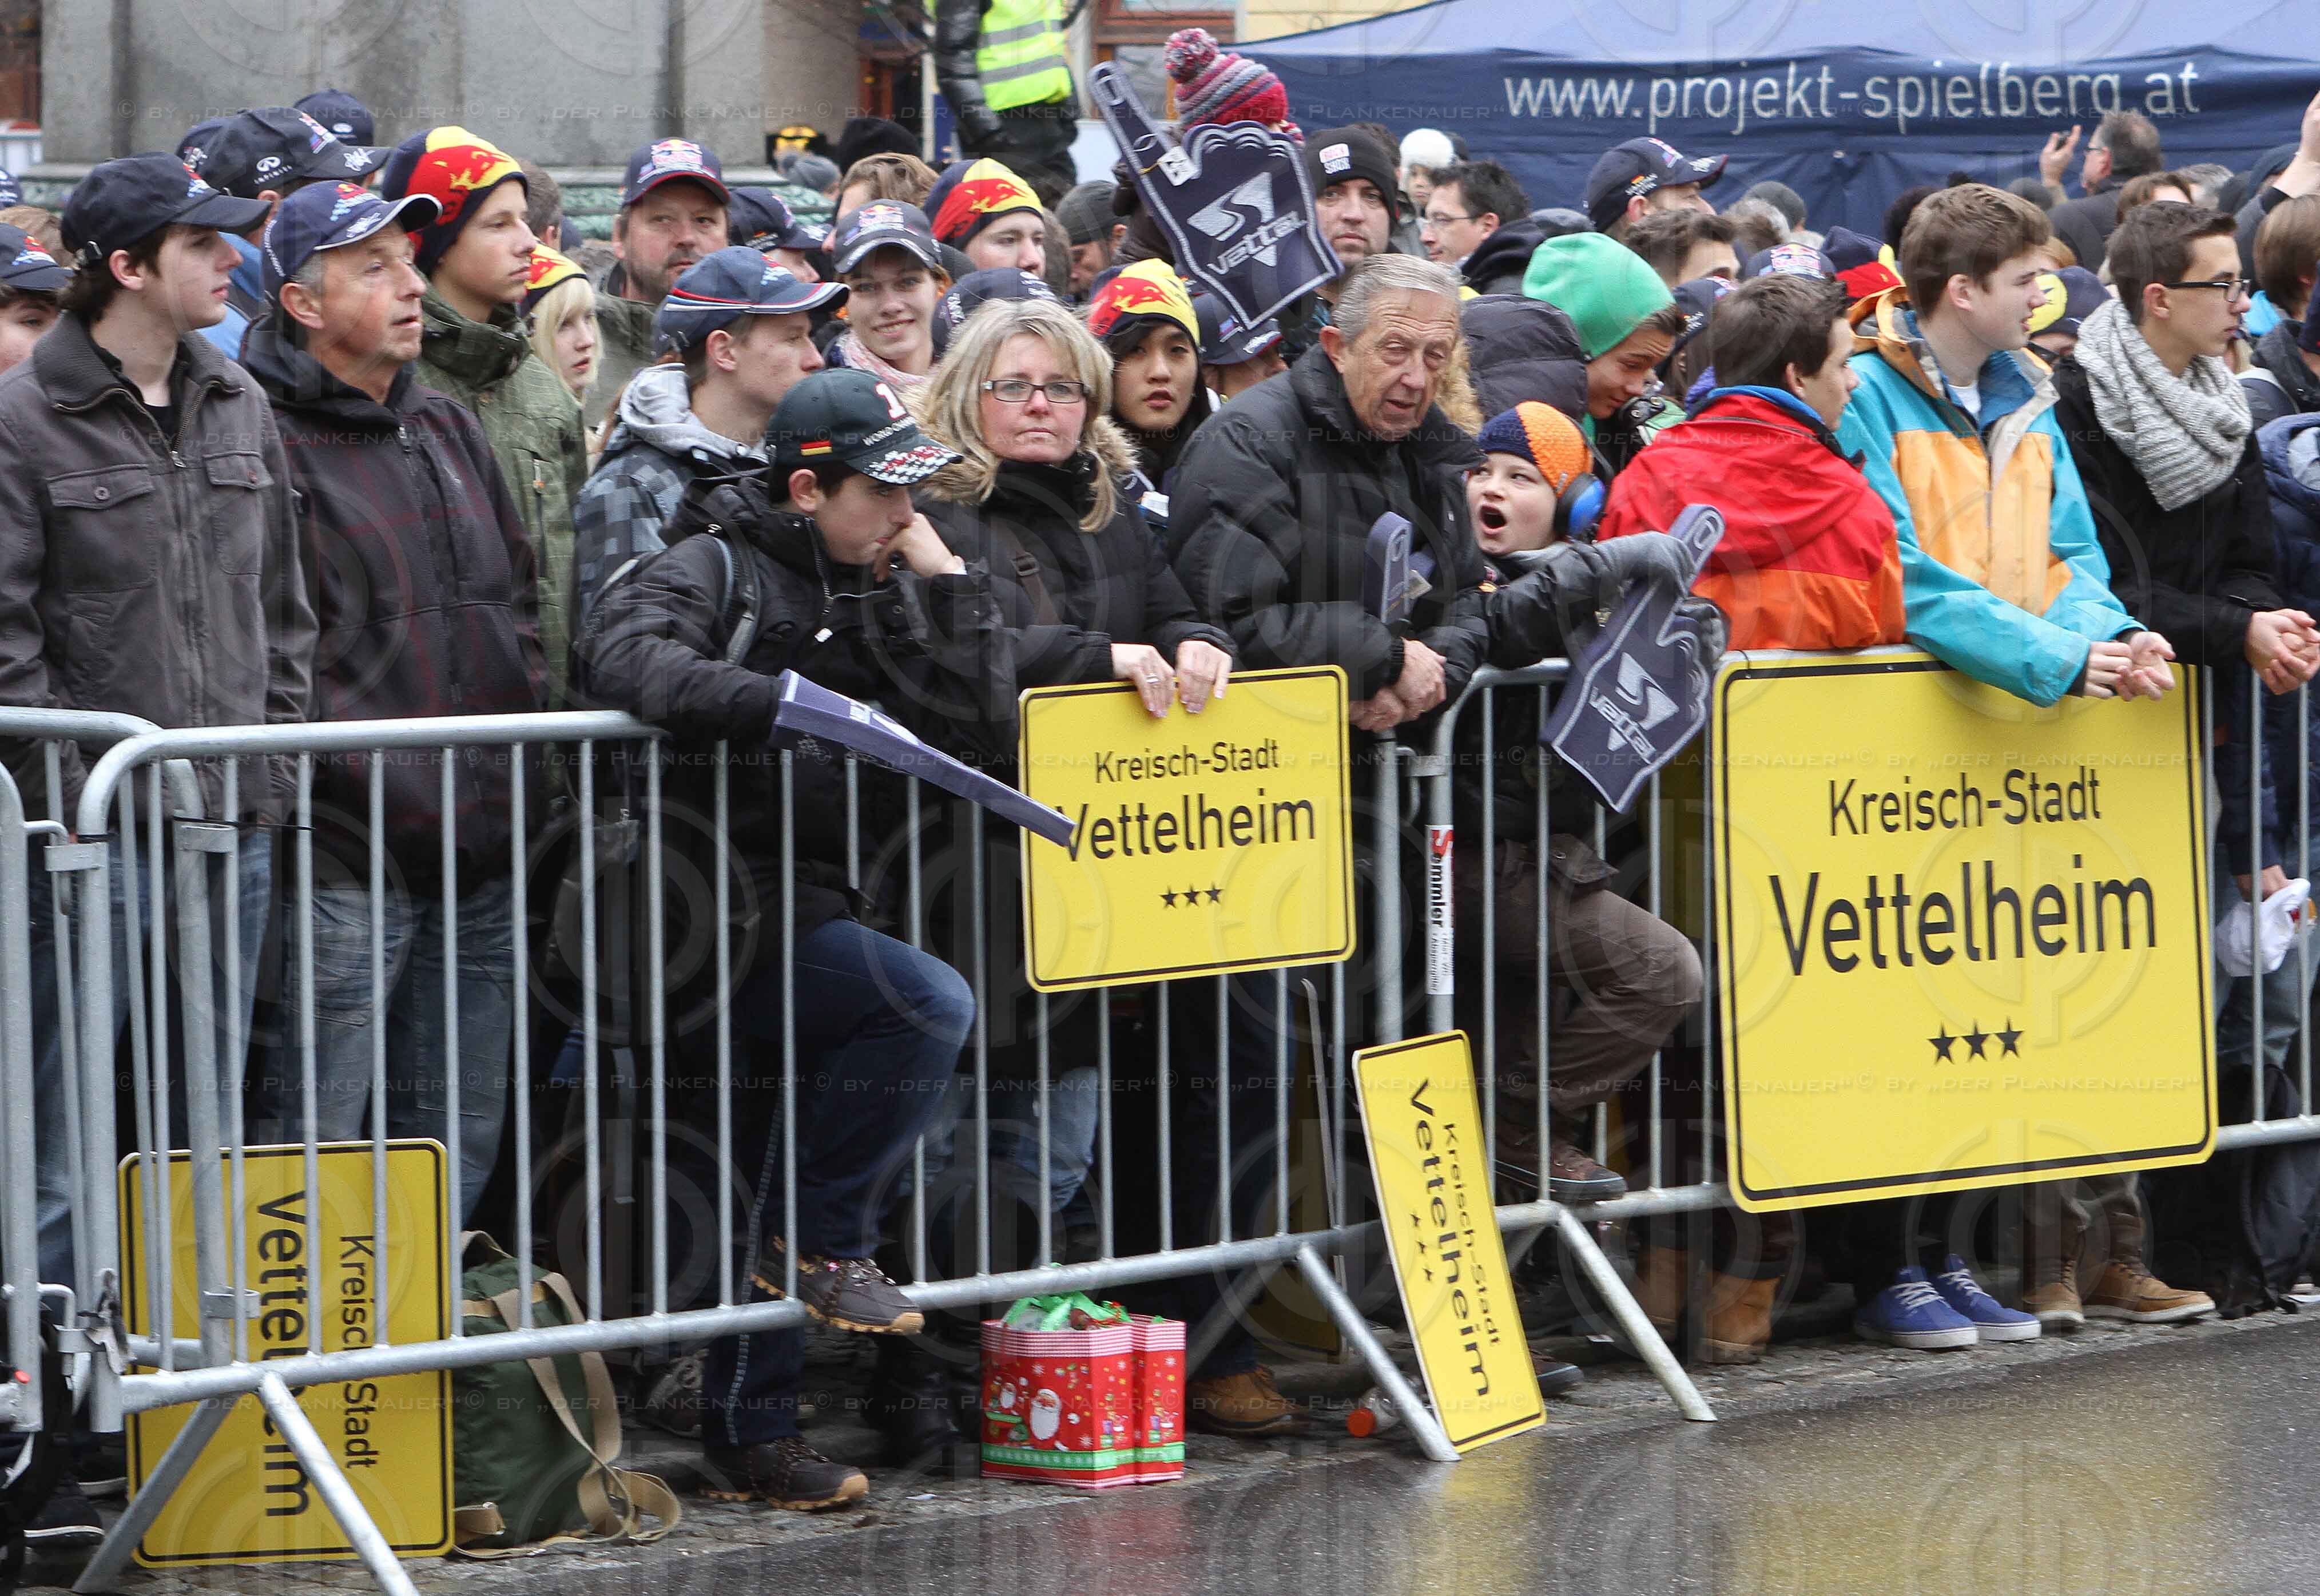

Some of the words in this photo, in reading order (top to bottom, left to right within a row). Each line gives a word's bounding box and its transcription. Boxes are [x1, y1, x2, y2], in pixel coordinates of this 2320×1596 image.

[1504, 60, 2202, 136] www.projekt-spielbergat
[874, 382, 909, 420] 1
[1095, 738, 1280, 784] Kreisch-Stadt
[1829, 767, 2101, 836] Kreisch-Stadt
[1056, 788, 1315, 862] Vettelheim
[1432, 829, 1455, 928] Semmler
[1769, 853, 2156, 976] Vettelheim
[1409, 1078, 1489, 1398] Vettelheim
[1443, 1123, 1501, 1347] Kreisch-Stadt
[340, 1236, 380, 1469] KreiscStadt
